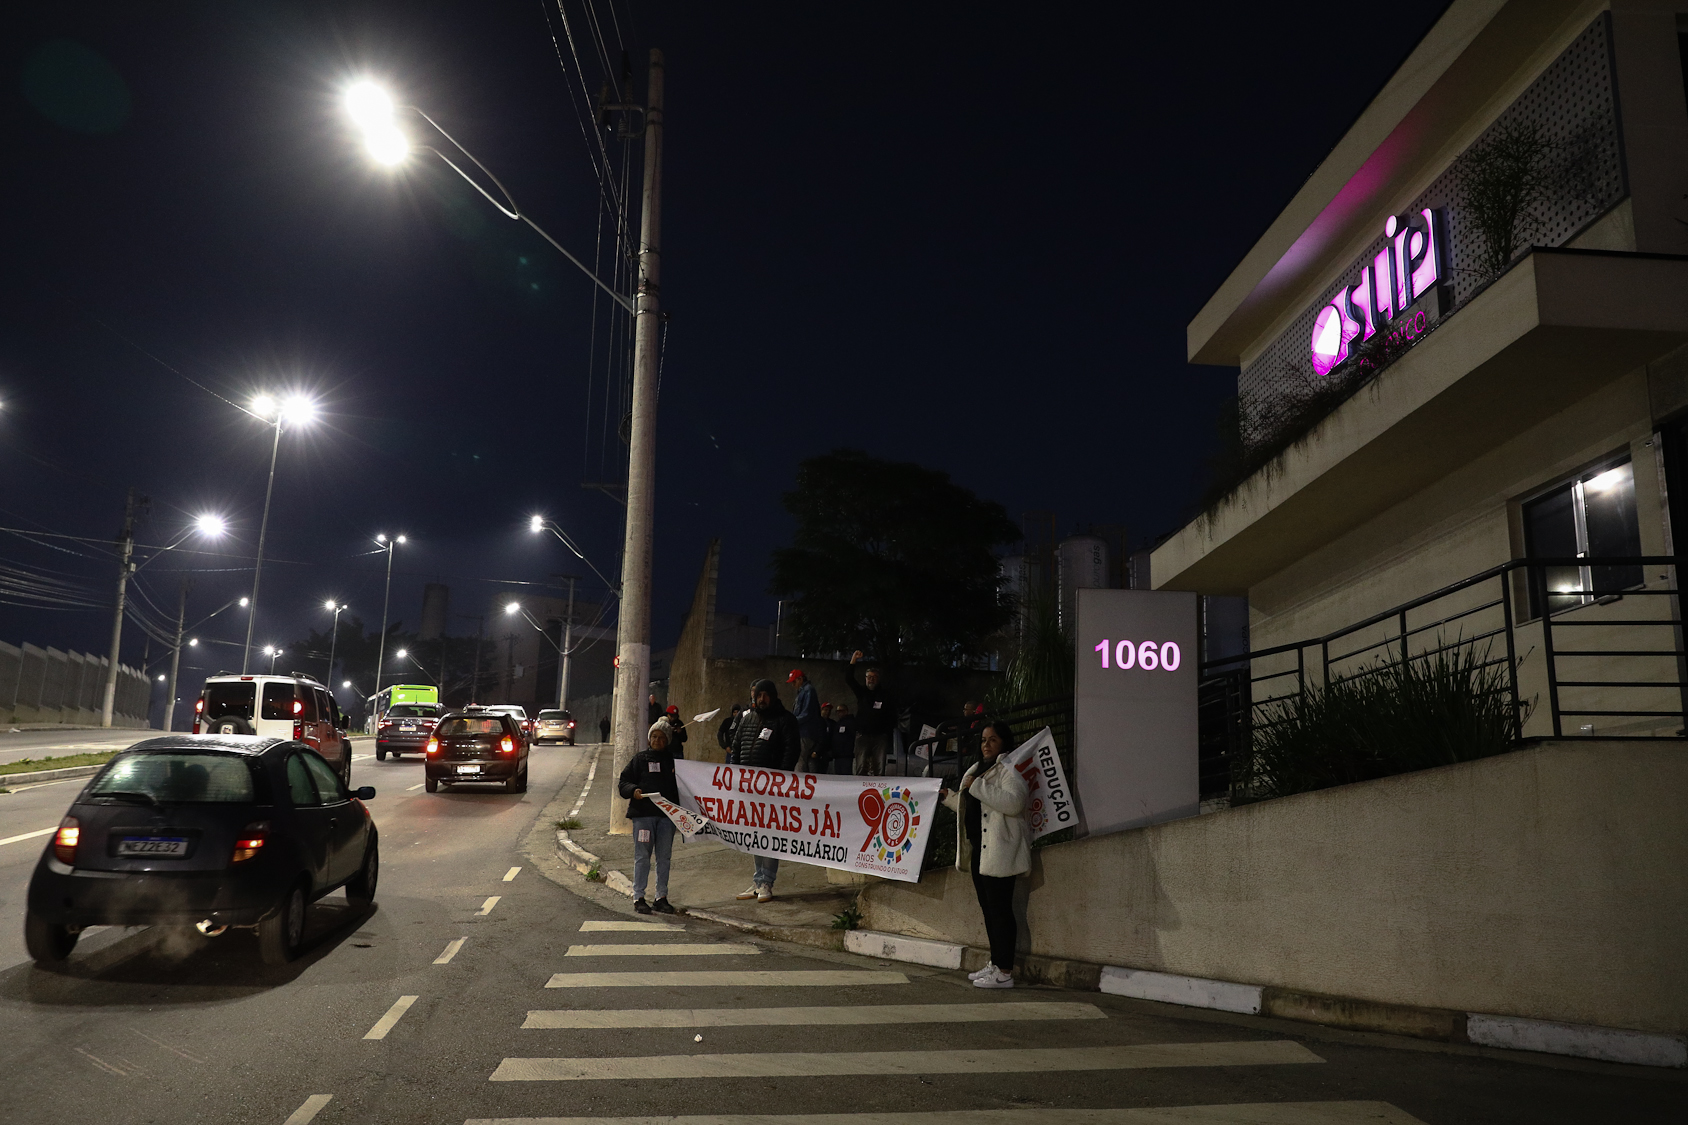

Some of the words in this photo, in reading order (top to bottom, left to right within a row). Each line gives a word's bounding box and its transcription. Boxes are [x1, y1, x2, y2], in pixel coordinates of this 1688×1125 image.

[1094, 639, 1181, 672] 1060
[712, 766, 733, 791] 40
[739, 768, 817, 800] HORAS
[1038, 745, 1070, 822] REDUÇÃO
[694, 795, 802, 833] SEMANAIS
[808, 804, 842, 838] JÁ!
[858, 788, 909, 852] 90
[772, 836, 788, 853] DE
[790, 839, 848, 864] SALÁRIO!
[856, 853, 875, 863] ANOS
